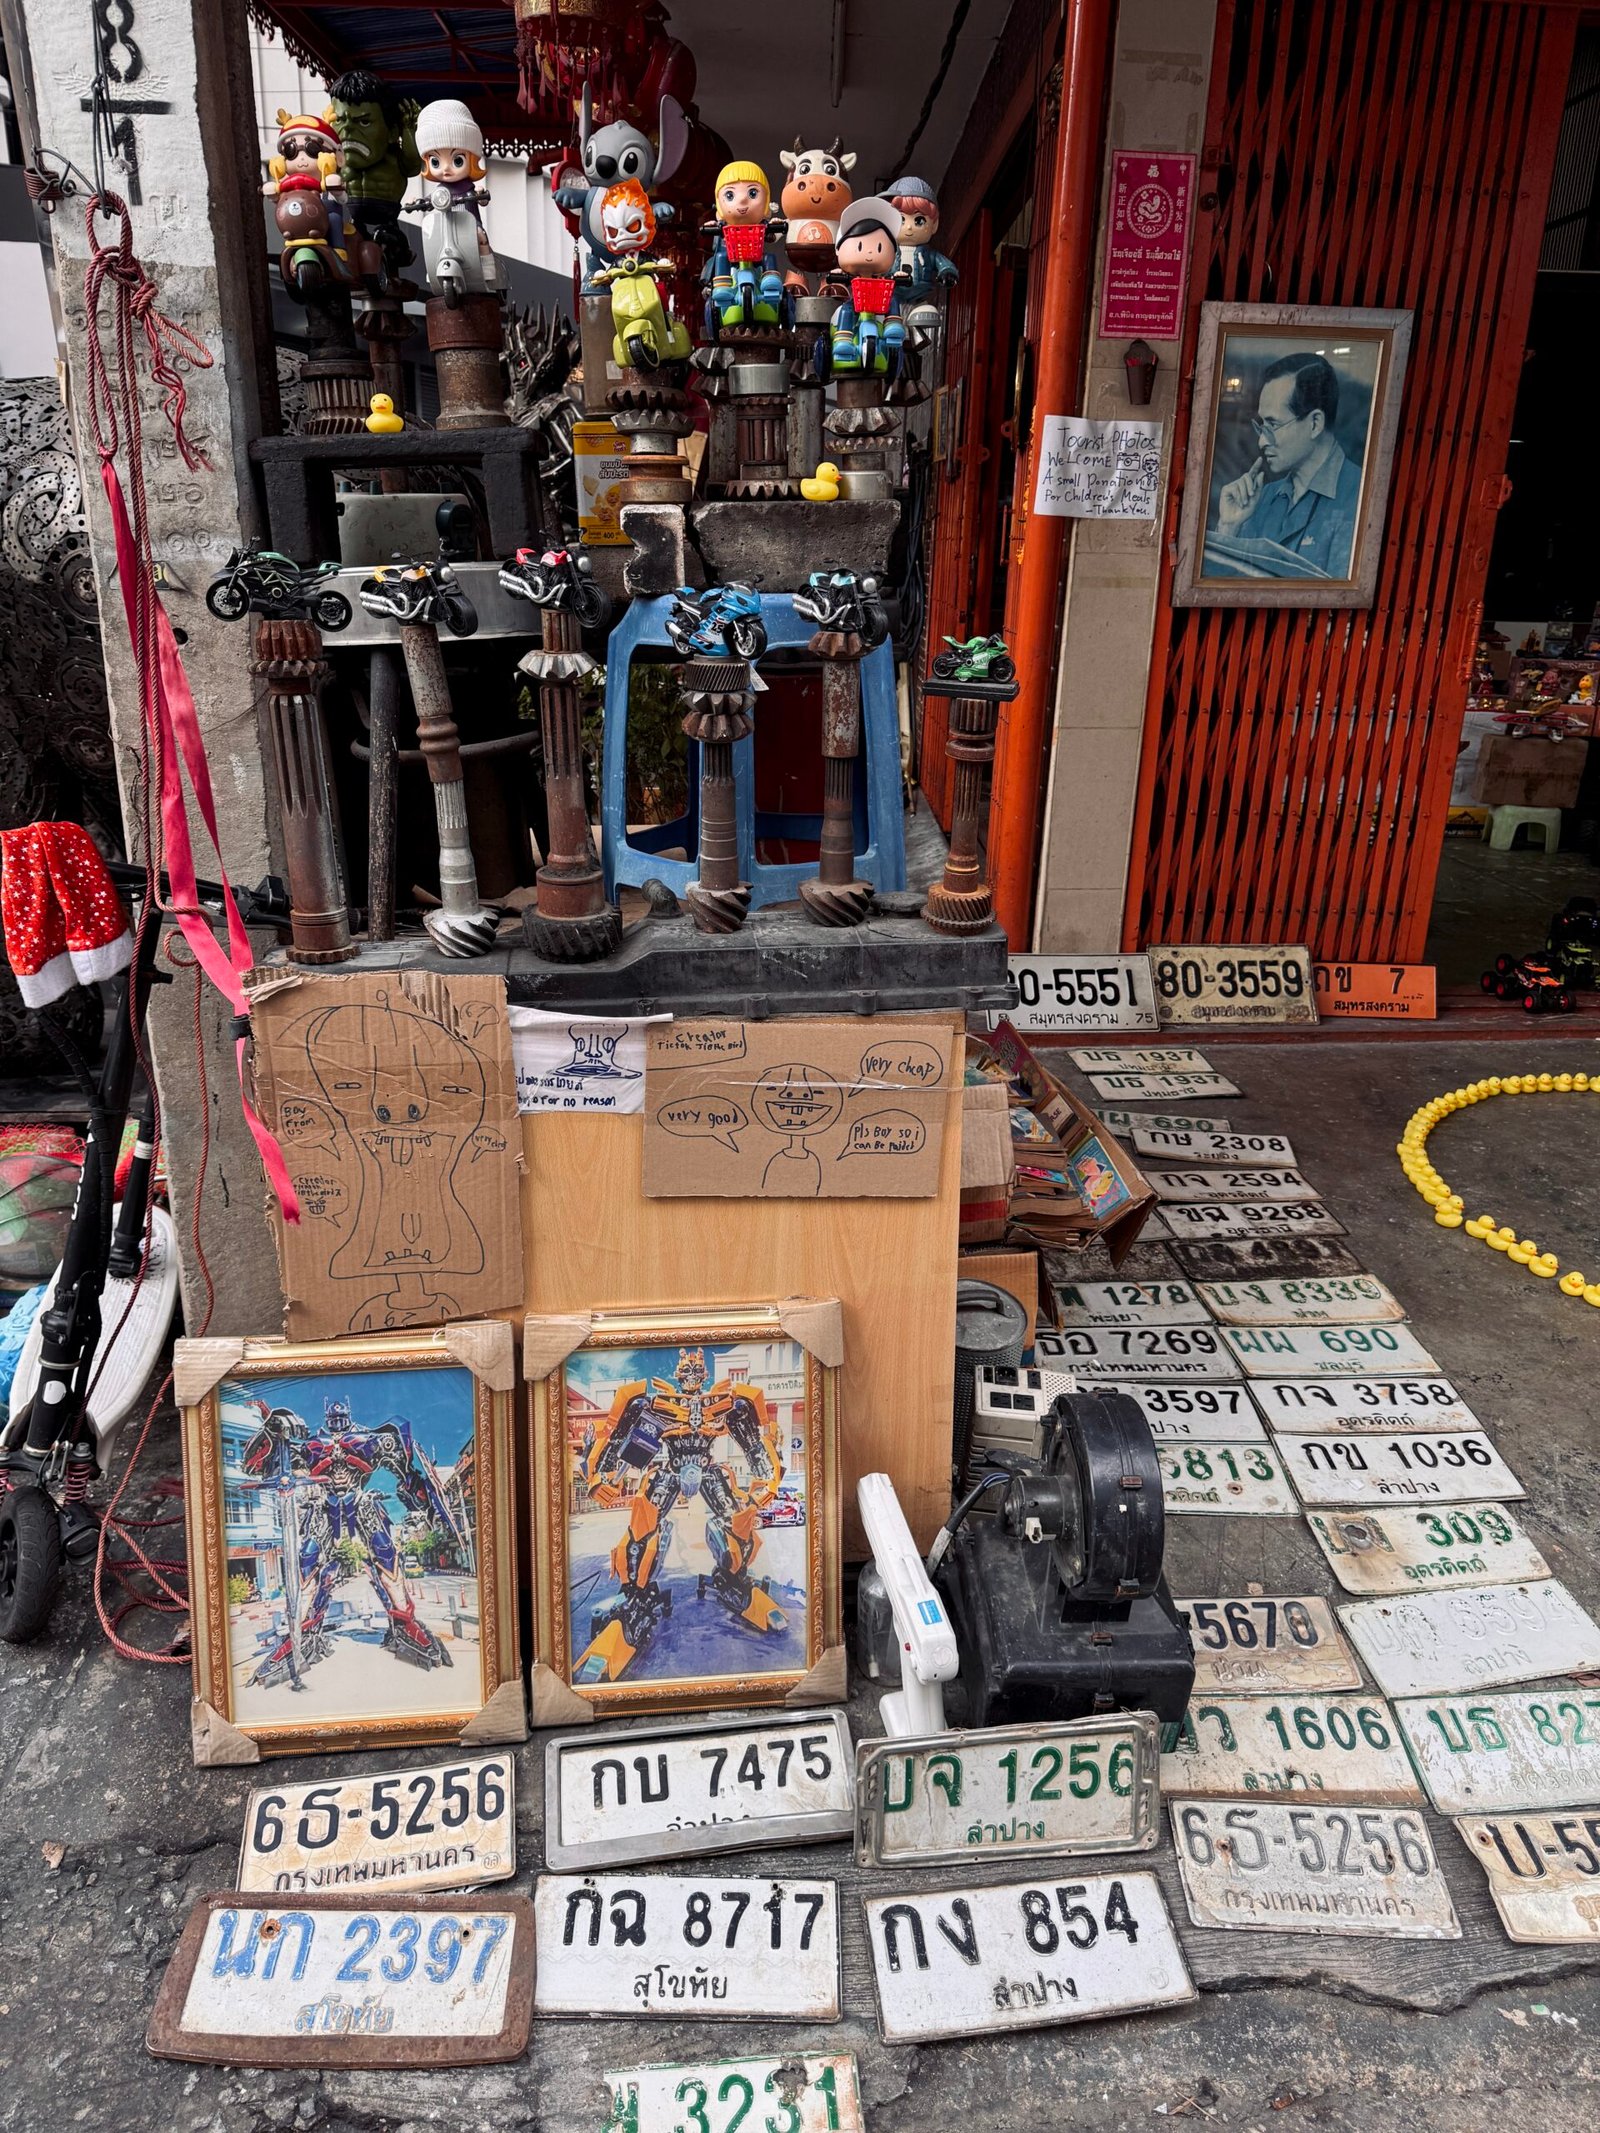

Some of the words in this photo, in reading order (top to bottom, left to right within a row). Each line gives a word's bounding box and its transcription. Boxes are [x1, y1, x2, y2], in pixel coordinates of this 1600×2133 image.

[1147, 164, 1160, 178] 福
[1115, 183, 1128, 232] 新正如意
[1158, 959, 1304, 998] 80-3559
[1390, 967, 1405, 995] 7
[1029, 1012, 1119, 1028] สมุทรสงคราม
[1135, 1012, 1153, 1023] 75
[1332, 1000, 1410, 1014] สมุทรสงคราม
[1082, 1051, 1121, 1062] บธ
[1136, 1050, 1194, 1062] 1937
[1104, 1075, 1145, 1088] บธ
[1159, 1075, 1221, 1087] 1937
[708, 1108, 739, 1128] good
[1153, 1115, 1215, 1132] 690
[1210, 1134, 1286, 1152] 2308
[1160, 1173, 1211, 1188] กจ
[1222, 1172, 1301, 1187] 2594
[1240, 1205, 1326, 1221] 9268
[1102, 1285, 1191, 1307] 1278
[1279, 1278, 1383, 1304] 8339
[1088, 1313, 1143, 1323] พะเยา
[1035, 1331, 1099, 1356] ธอ
[1108, 1329, 1218, 1355] 7269
[1319, 1328, 1399, 1353] 690
[1068, 1362, 1208, 1377] กรุงเทพมหานคร
[1144, 1389, 1240, 1414] 3597
[1273, 1384, 1338, 1406] กจ
[1353, 1382, 1454, 1406] 3758
[1151, 1420, 1191, 1434] ปาง
[1337, 1412, 1415, 1427] อุตรดิตถ์
[1388, 1438, 1493, 1470] 1036
[1377, 1478, 1441, 1494] ลำปาง
[1416, 1507, 1514, 1548] 309
[1403, 1552, 1488, 1583] อุตรดิตถ์
[1187, 1600, 1319, 1650] 5670
[1265, 1705, 1391, 1751] 1606
[1426, 1704, 1510, 1754] บธ
[589, 1753, 670, 1811] กบ
[699, 1734, 832, 1798] 7475
[998, 1741, 1135, 1803] 1256
[252, 1762, 507, 1855] 6ธ-5256
[966, 1816, 1047, 1845] ลำปาง
[1180, 1806, 1431, 1878] 6ธ-5256
[273, 1843, 477, 1894] กรงเทพมหานคร
[1223, 1887, 1417, 1917] กรุงเทพมหานคร
[561, 1887, 648, 1948] กฉ
[682, 1890, 825, 1950] 8717
[880, 1896, 982, 1974] กง
[1018, 1880, 1140, 1958] 854
[209, 1908, 317, 1983] นก
[335, 1913, 510, 1986] 2397
[632, 1963, 729, 2008] สุโขทัย
[991, 1969, 1080, 2011] ลำปาง
